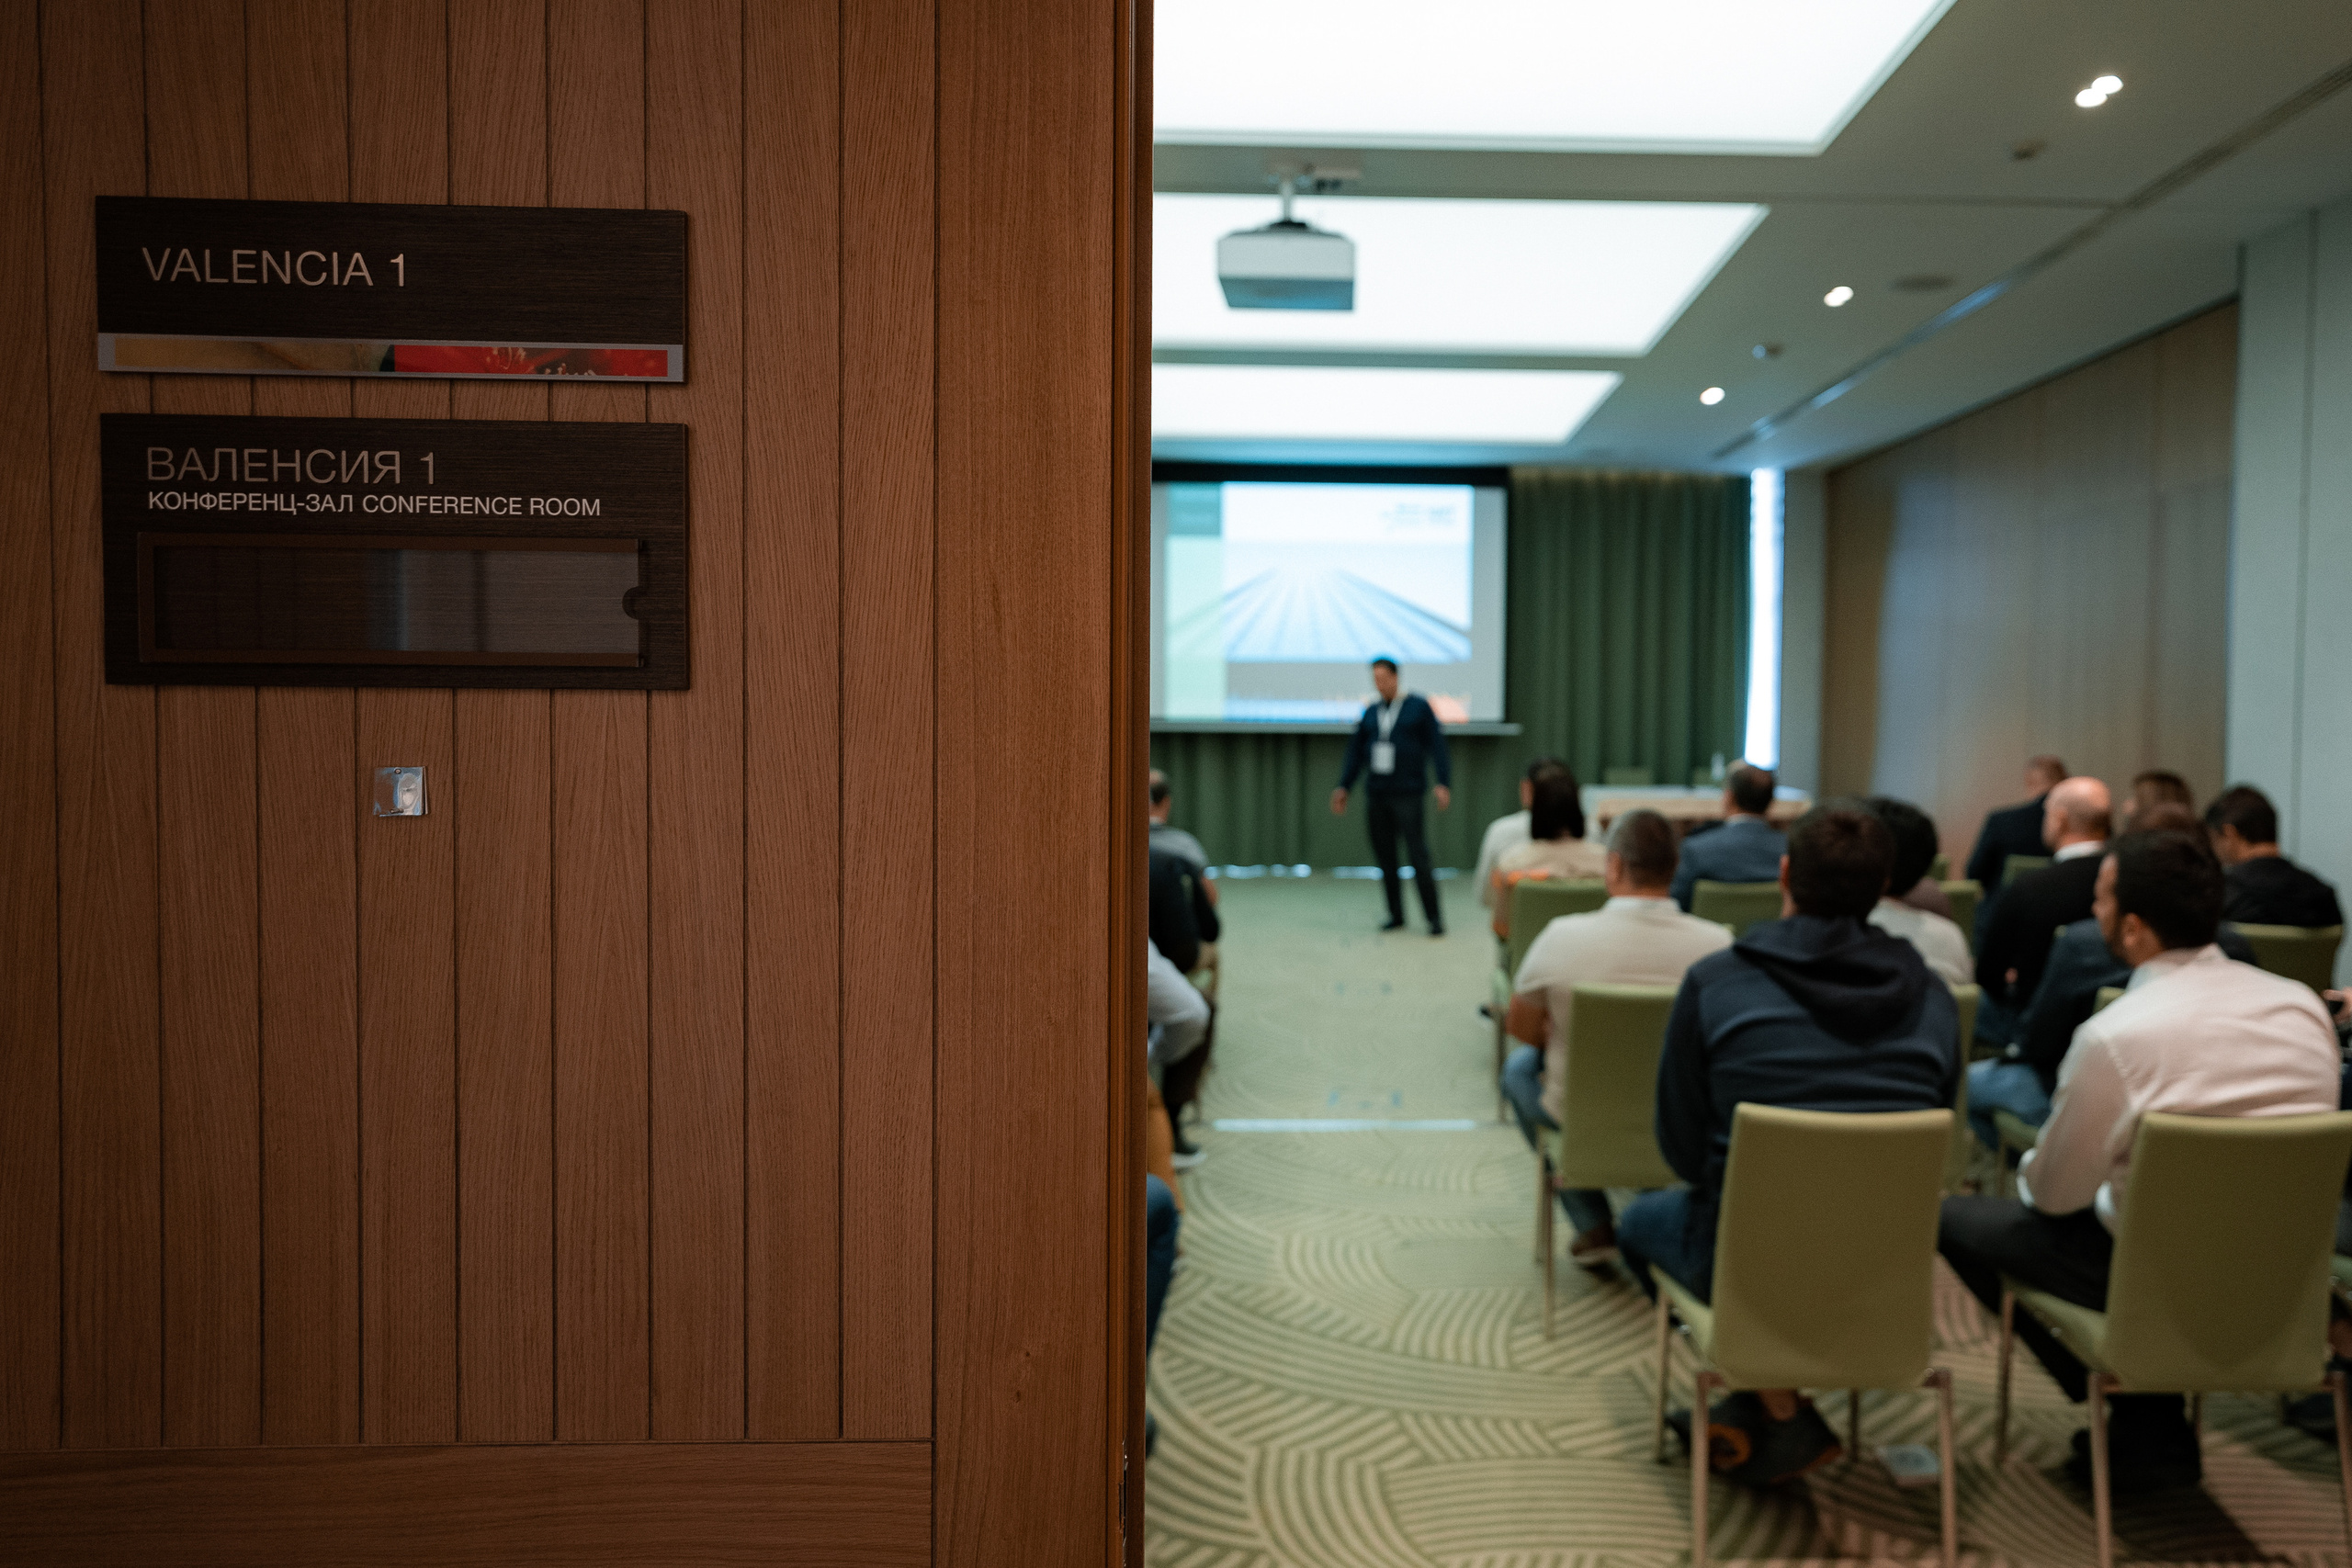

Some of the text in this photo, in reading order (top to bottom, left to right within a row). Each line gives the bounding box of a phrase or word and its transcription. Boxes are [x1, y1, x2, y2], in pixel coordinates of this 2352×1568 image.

[142, 247, 406, 288] VALENCIA 1
[147, 446, 435, 484] ВАЛЕНСИЯ 1
[149, 491, 601, 516] КОНФЕРЕНЦ-ЗАЛ CONFERENCE ROOM
